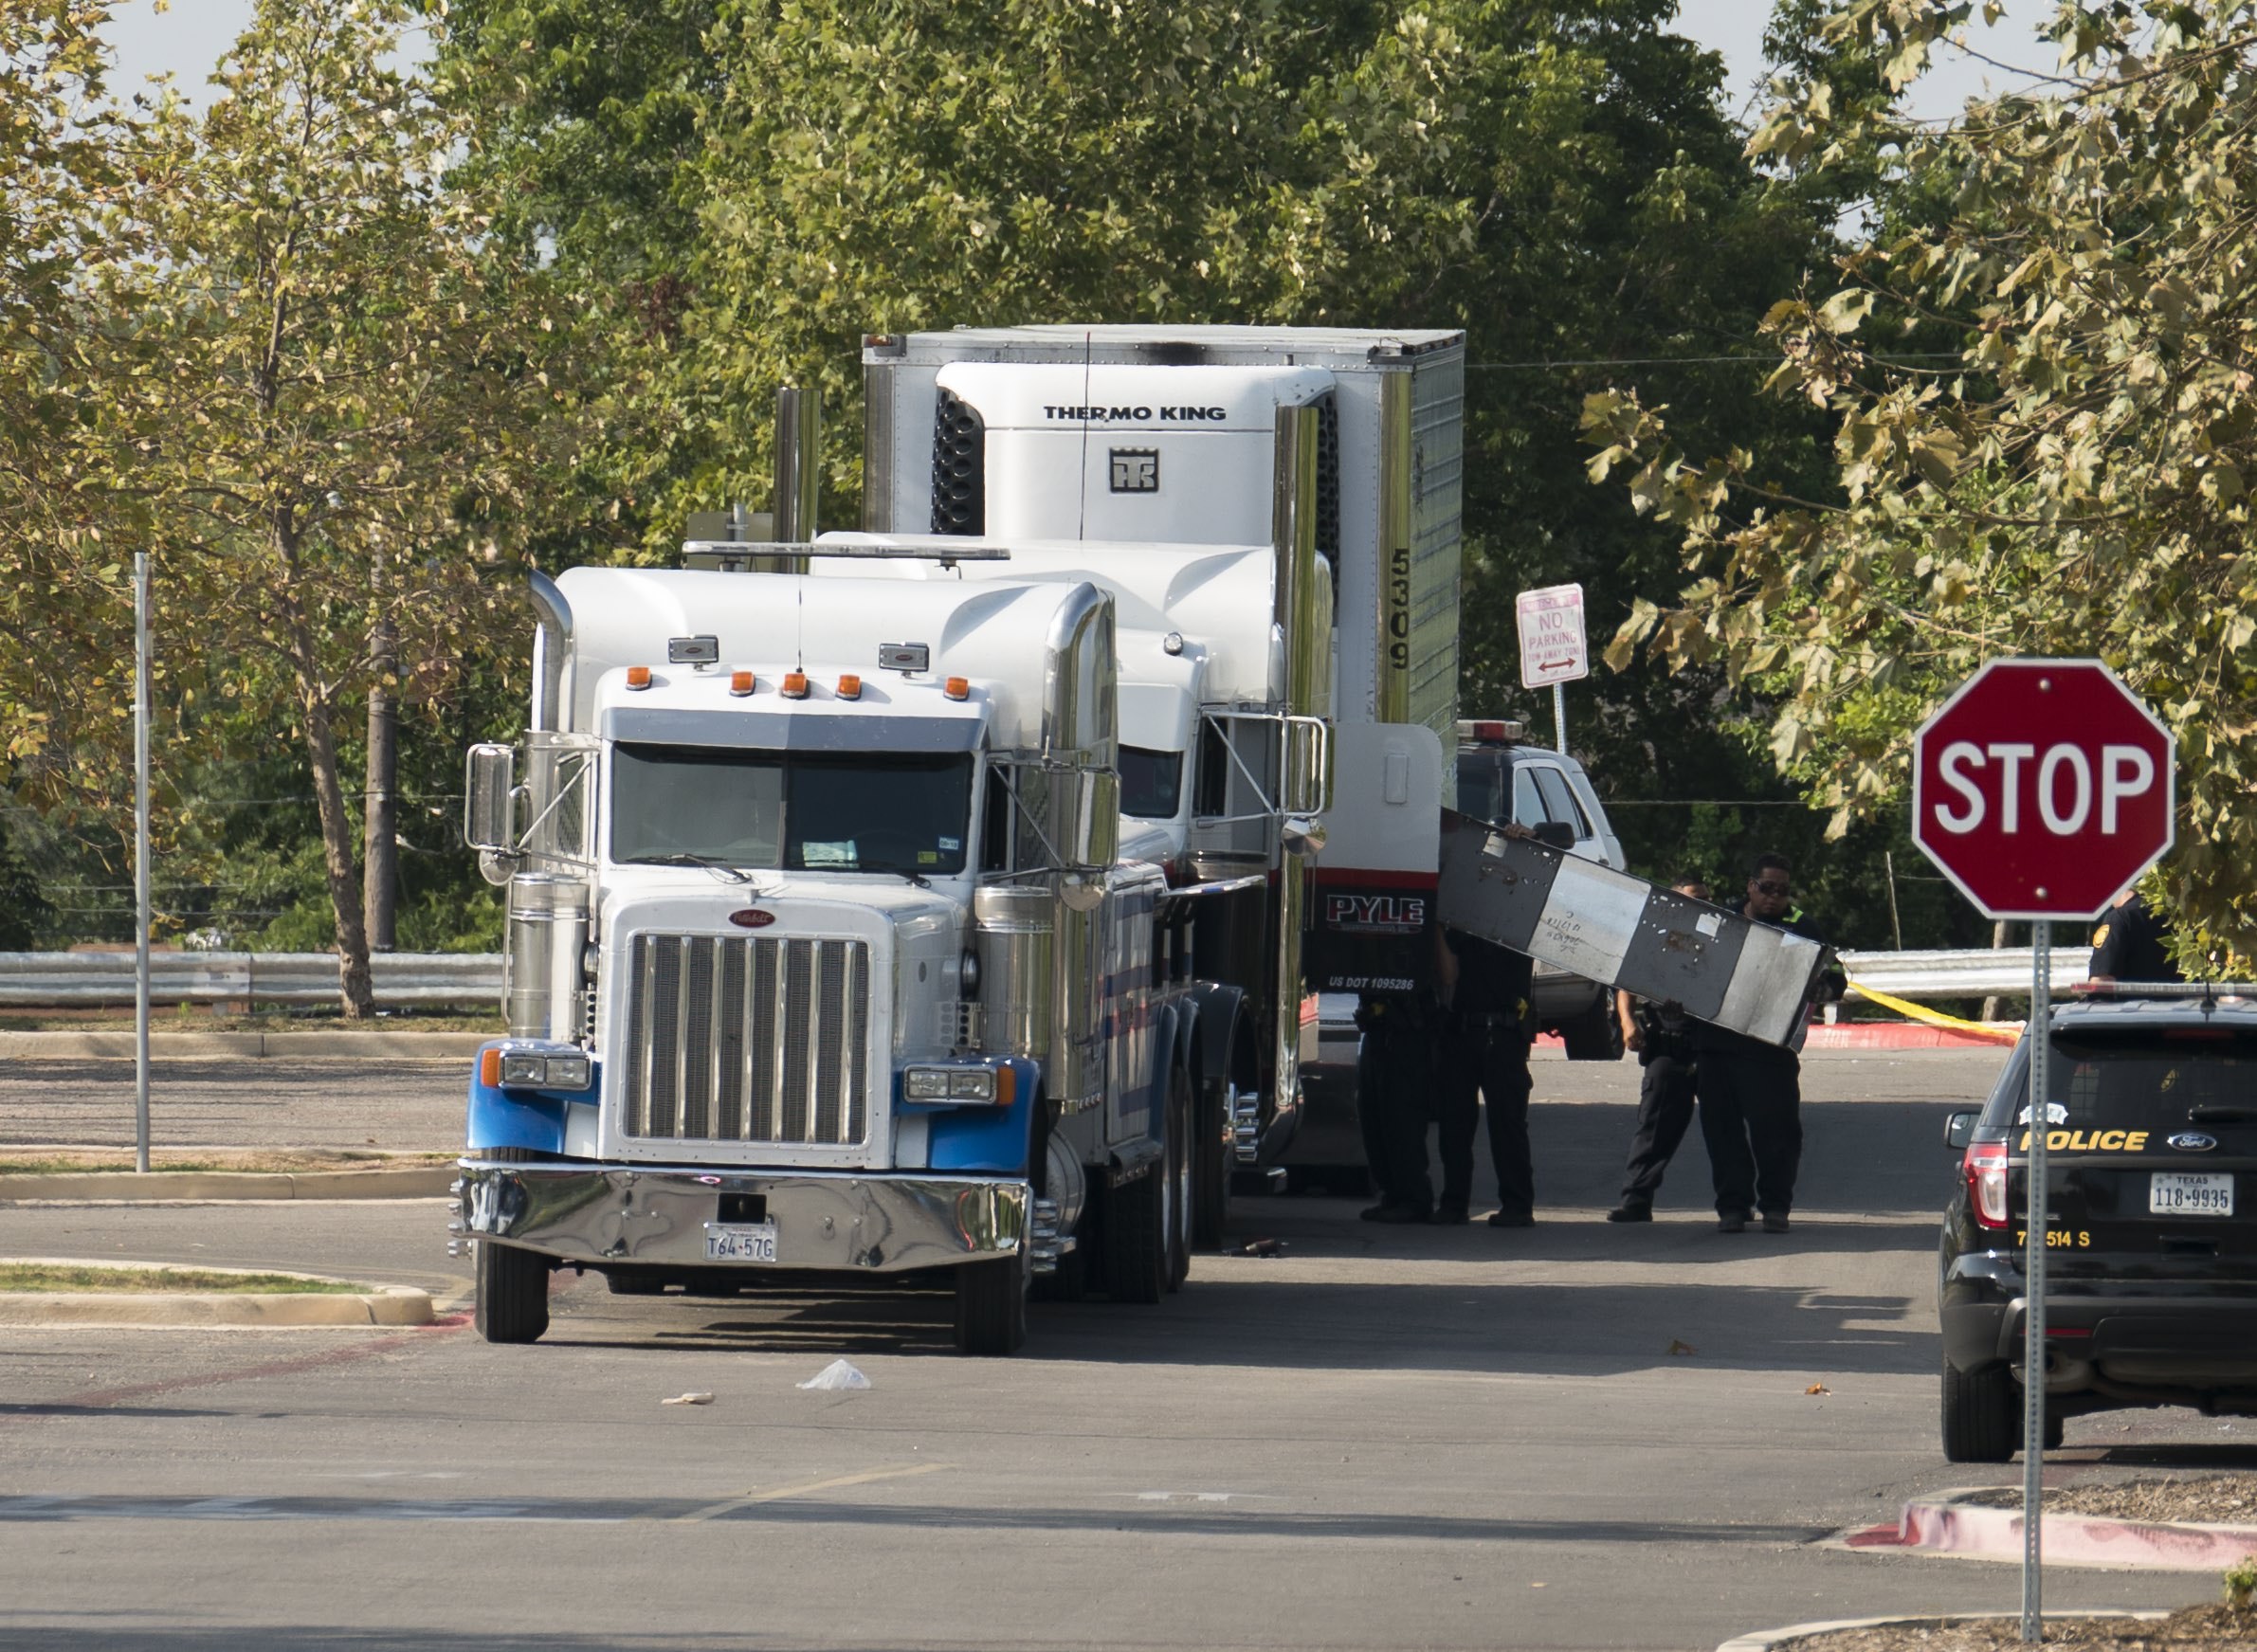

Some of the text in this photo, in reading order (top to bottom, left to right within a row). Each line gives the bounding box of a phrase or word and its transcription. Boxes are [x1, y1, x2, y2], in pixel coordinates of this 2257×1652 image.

[1044, 406, 1227, 421] THERMO KING
[1390, 548, 1410, 669] 5309
[1538, 611, 1563, 631] NO
[1528, 629, 1577, 649] PARKING
[1935, 741, 2155, 836] STOP
[1327, 895, 1425, 924] PYLE
[1329, 976, 1344, 987] US
[1346, 977, 1369, 988] DOT
[2179, 1135, 2206, 1147] Ford
[2176, 1176, 2209, 1185] TEXAS
[2079, 1231, 2090, 1247] S
